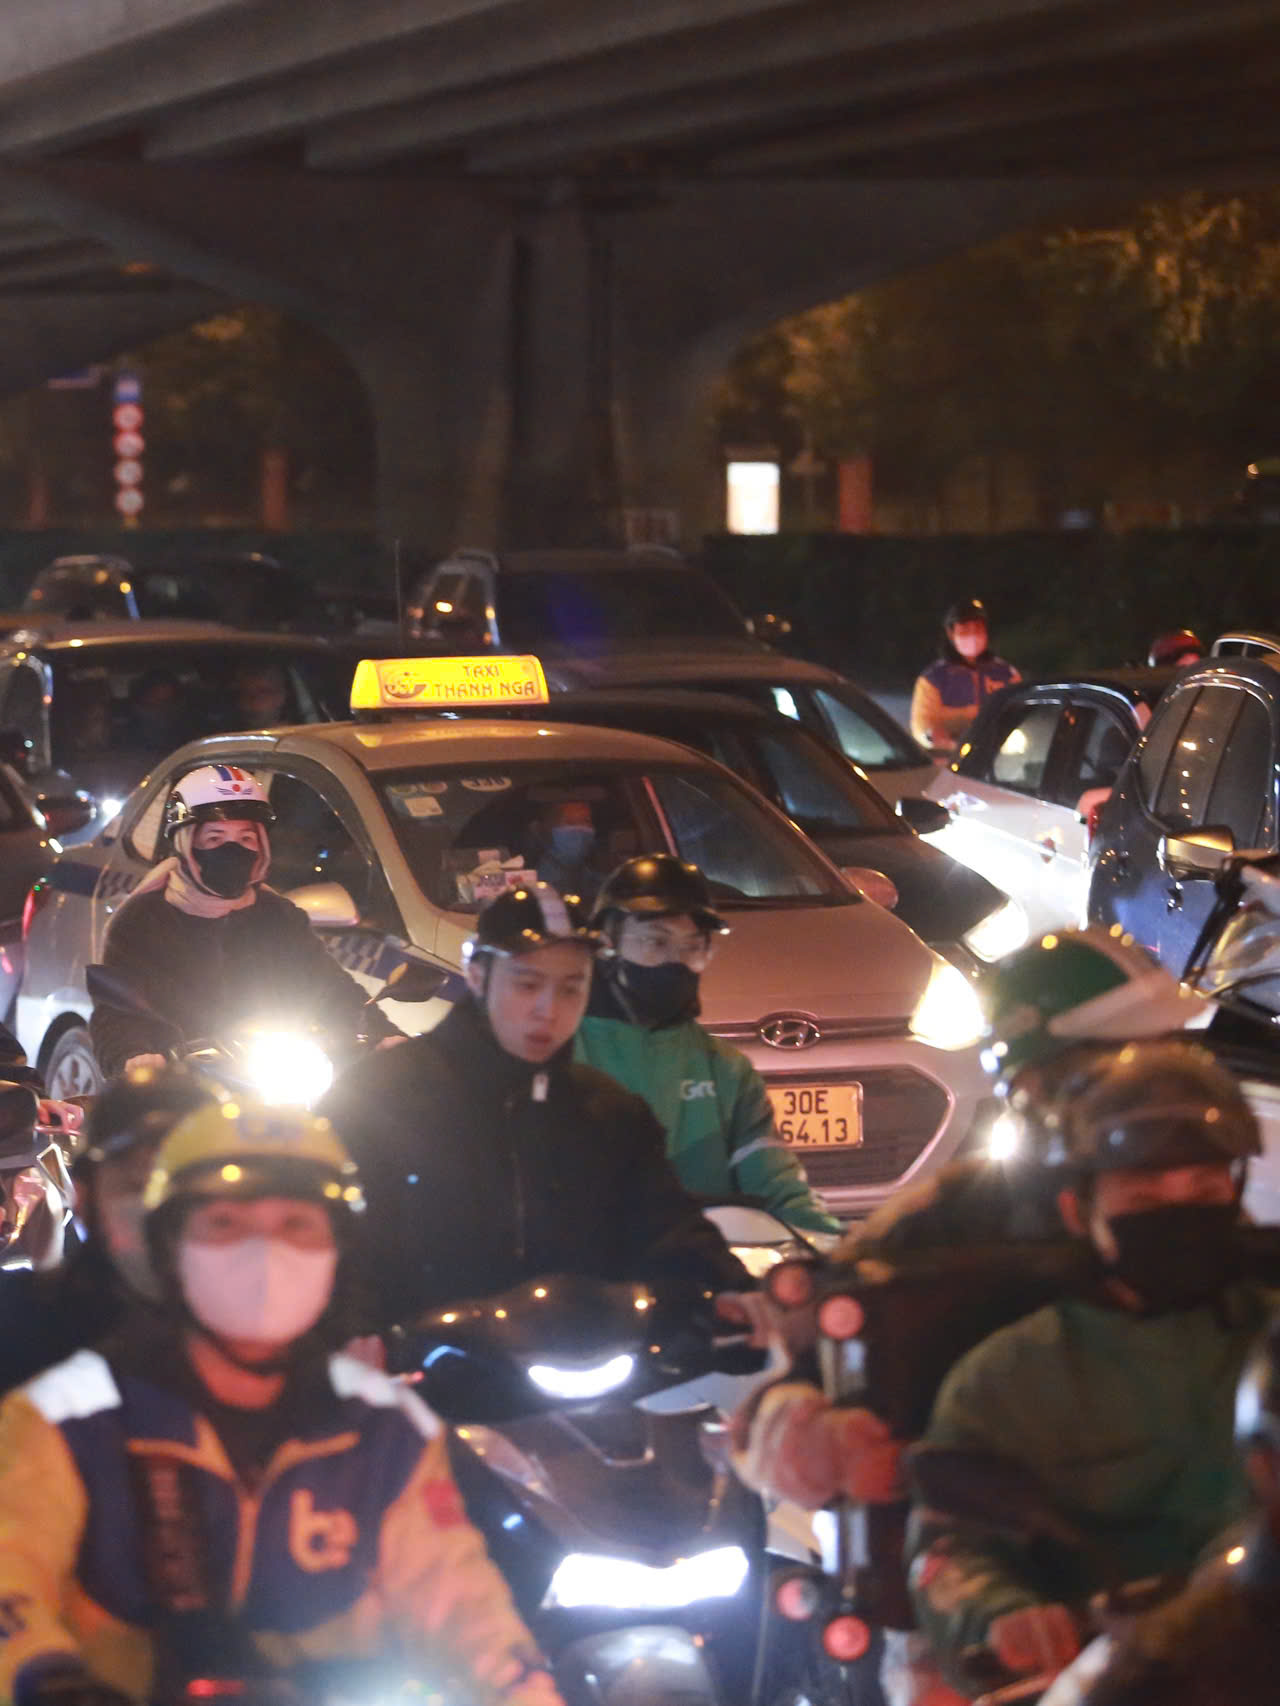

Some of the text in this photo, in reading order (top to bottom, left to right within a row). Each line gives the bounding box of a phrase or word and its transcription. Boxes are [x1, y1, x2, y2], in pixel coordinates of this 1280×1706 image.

[464, 665, 499, 677] TAXI
[435, 681, 535, 697] THANH NGA
[783, 1090, 829, 1115] 30E
[778, 1118, 848, 1144] 64.13
